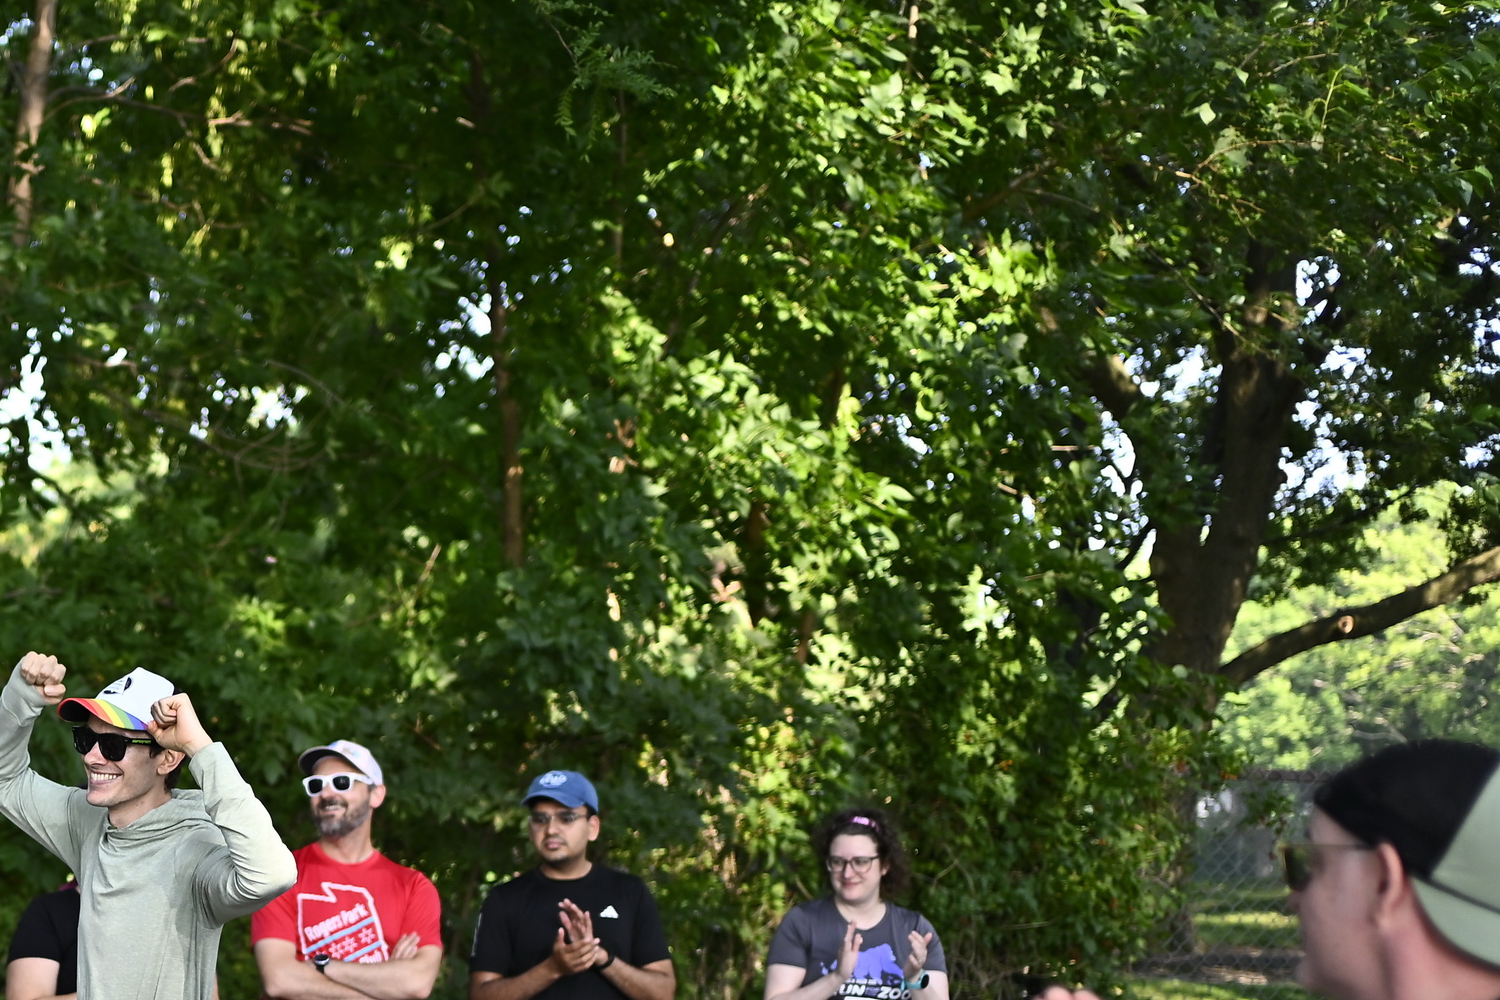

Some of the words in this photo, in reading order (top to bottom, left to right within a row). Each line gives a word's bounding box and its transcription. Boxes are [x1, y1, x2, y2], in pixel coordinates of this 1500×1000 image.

[304, 914, 342, 941] Rogers
[340, 903, 369, 926] Park
[834, 984, 866, 996] UN
[877, 985, 911, 1000] ZOO
